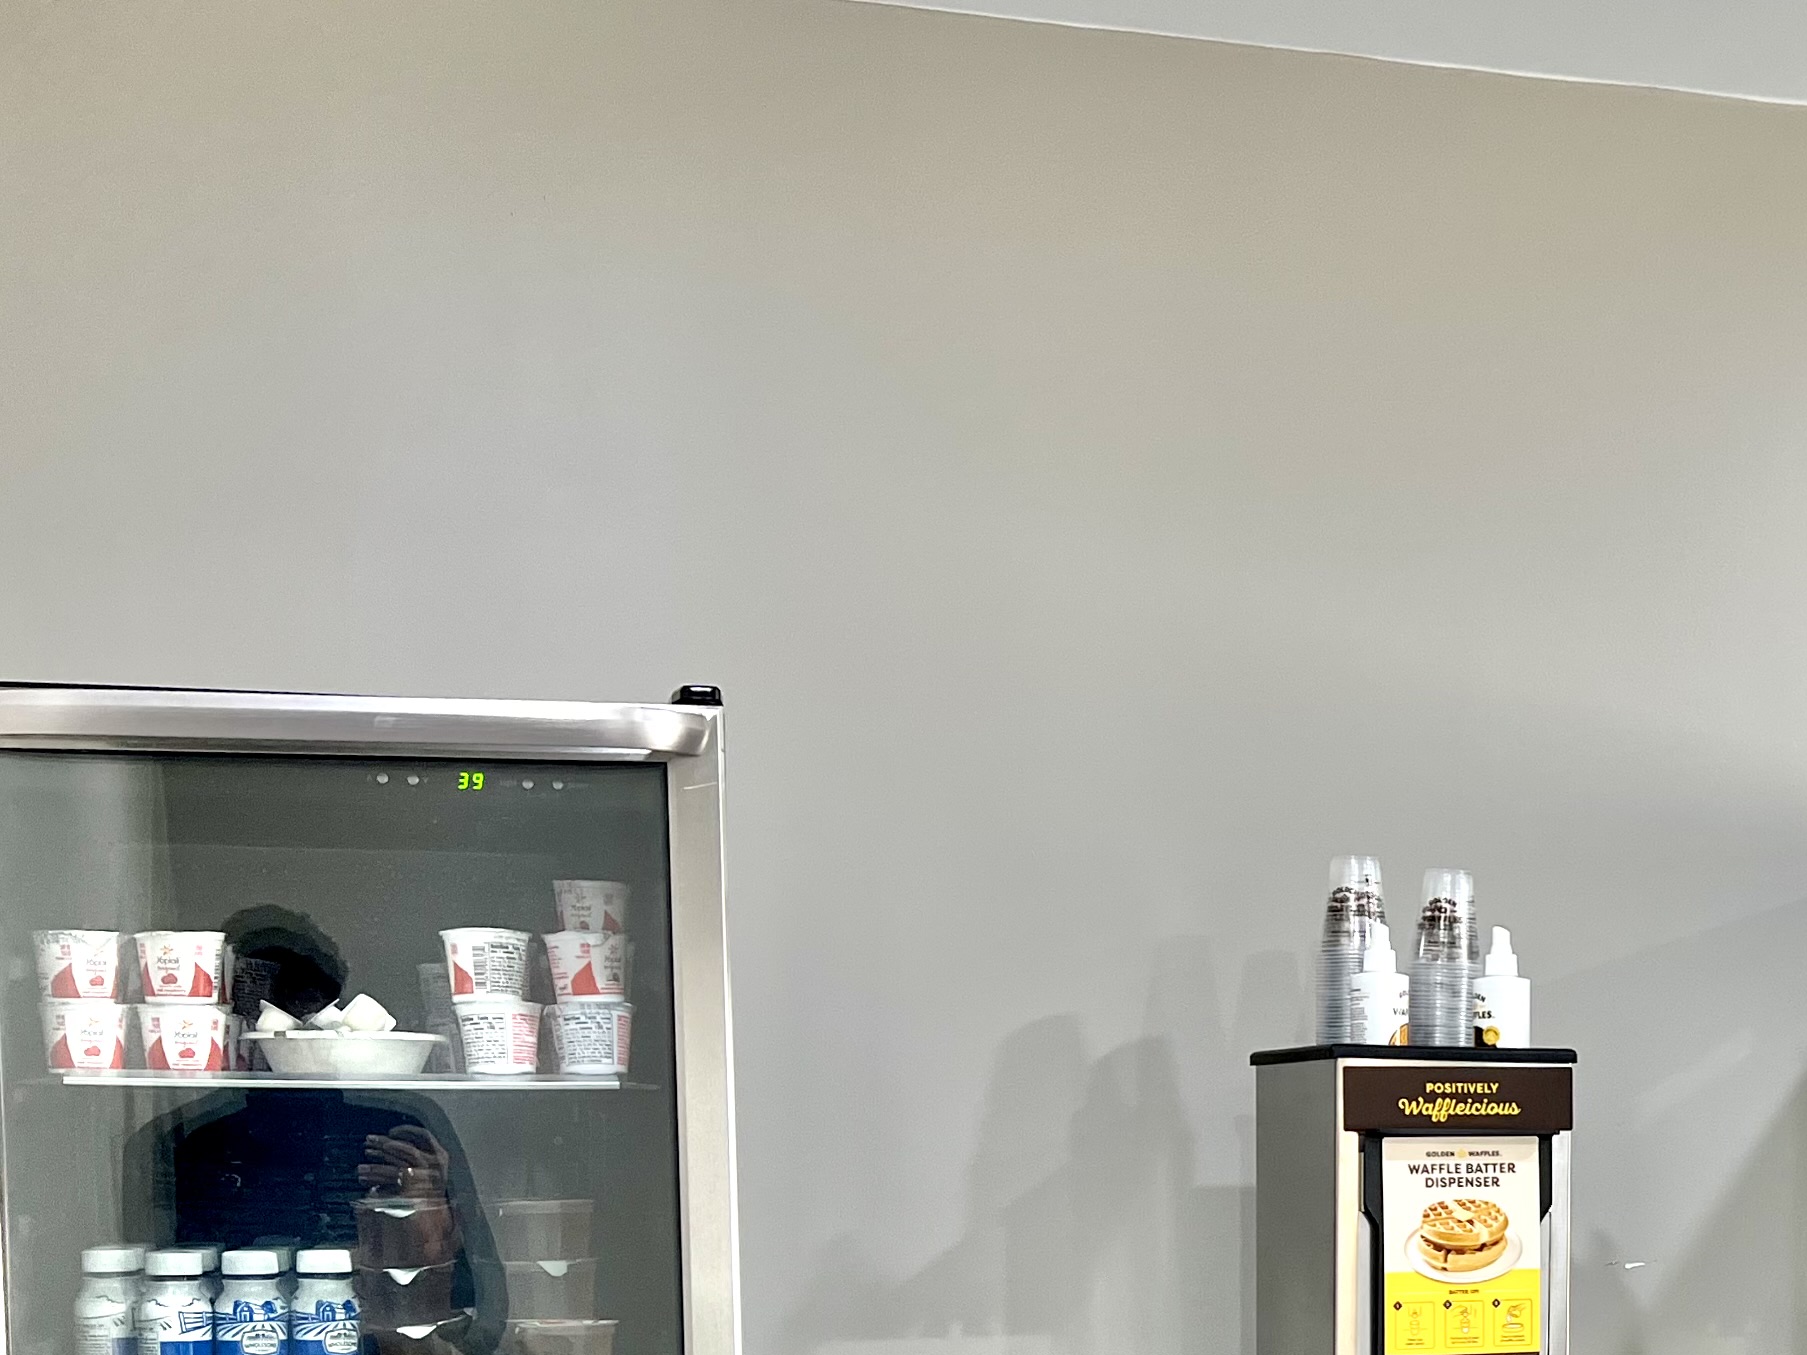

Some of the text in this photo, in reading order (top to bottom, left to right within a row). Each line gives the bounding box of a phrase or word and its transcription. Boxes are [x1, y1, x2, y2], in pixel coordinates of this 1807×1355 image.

[457, 771, 485, 791] 39
[1425, 1082, 1500, 1094] POSITIVELY
[1398, 1096, 1522, 1122] Waffleicious
[1408, 1162, 1517, 1175] WAFFLE BATTER
[1425, 1177, 1501, 1188] DISPENSER
